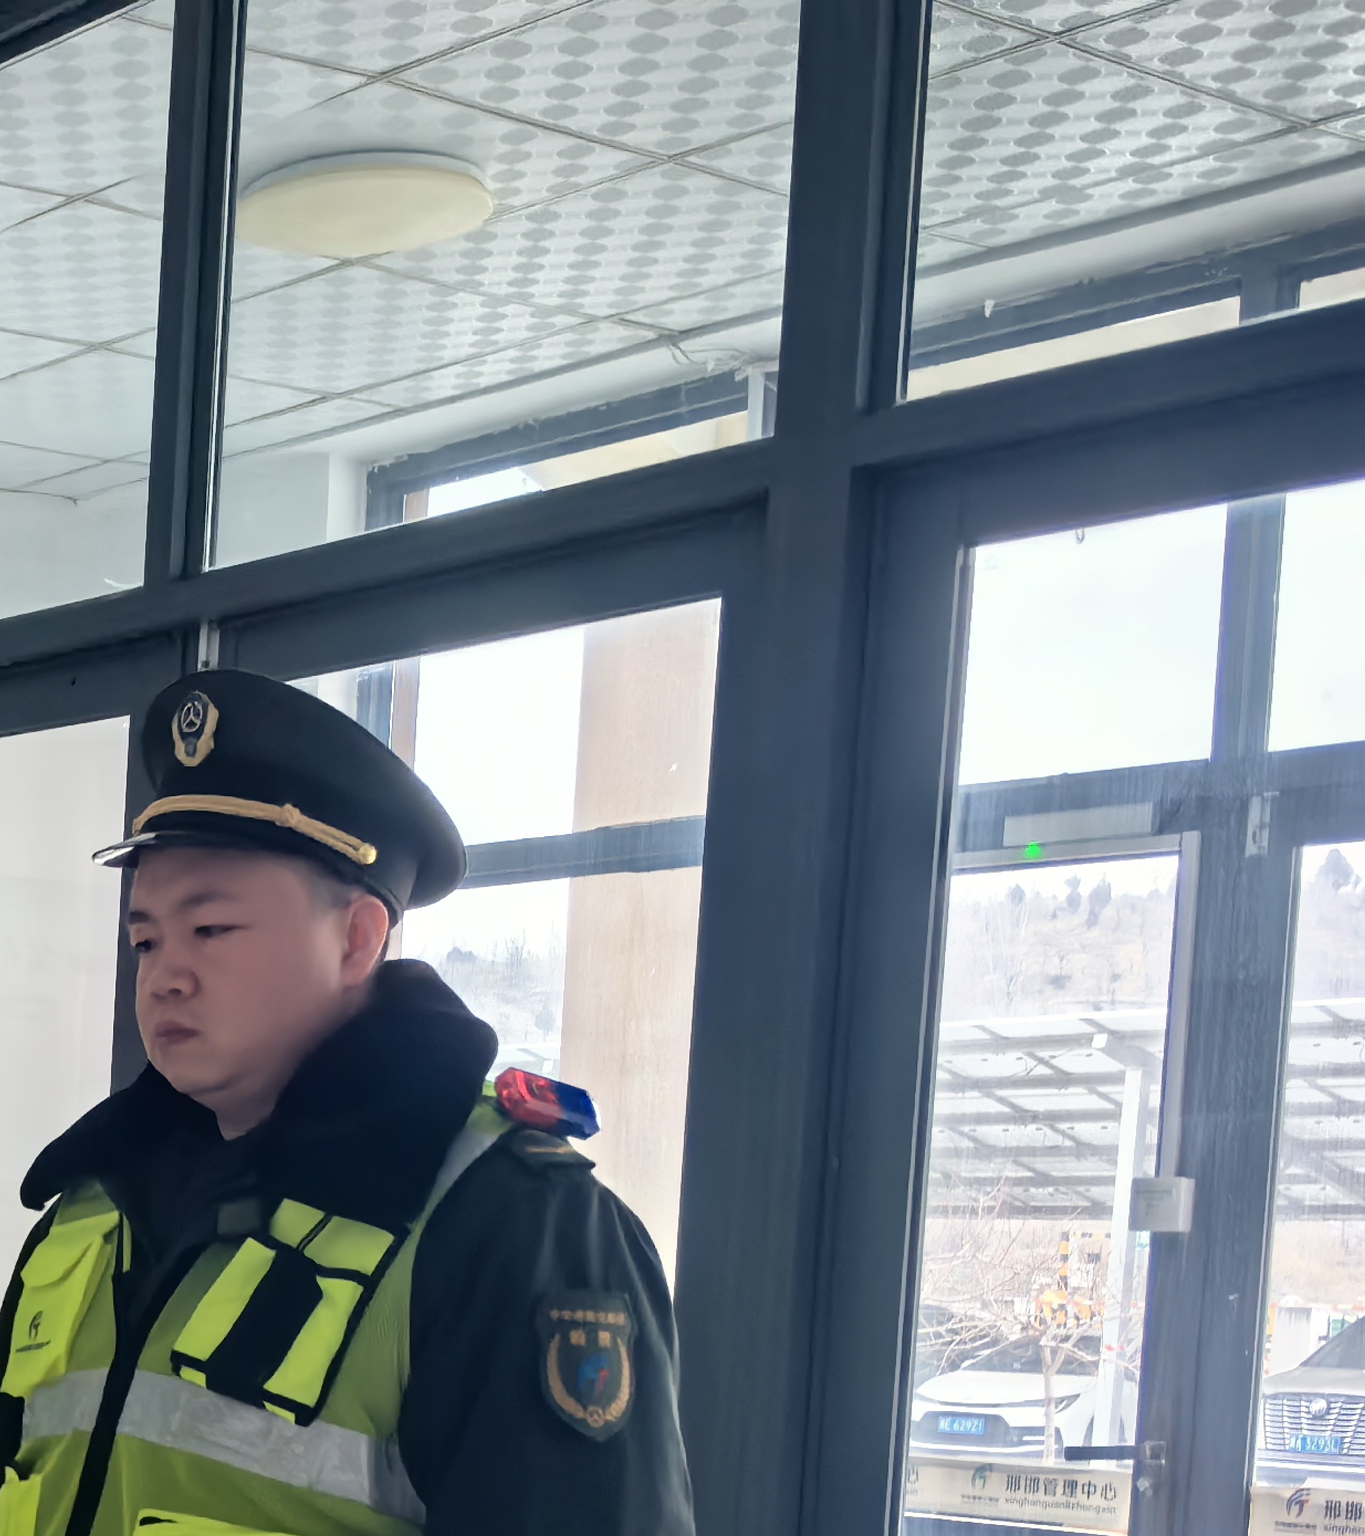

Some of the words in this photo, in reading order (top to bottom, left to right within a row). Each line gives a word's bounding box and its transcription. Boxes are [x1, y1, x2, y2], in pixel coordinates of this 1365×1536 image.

[1005, 1473, 1117, 1501] 邢邯管理中心
